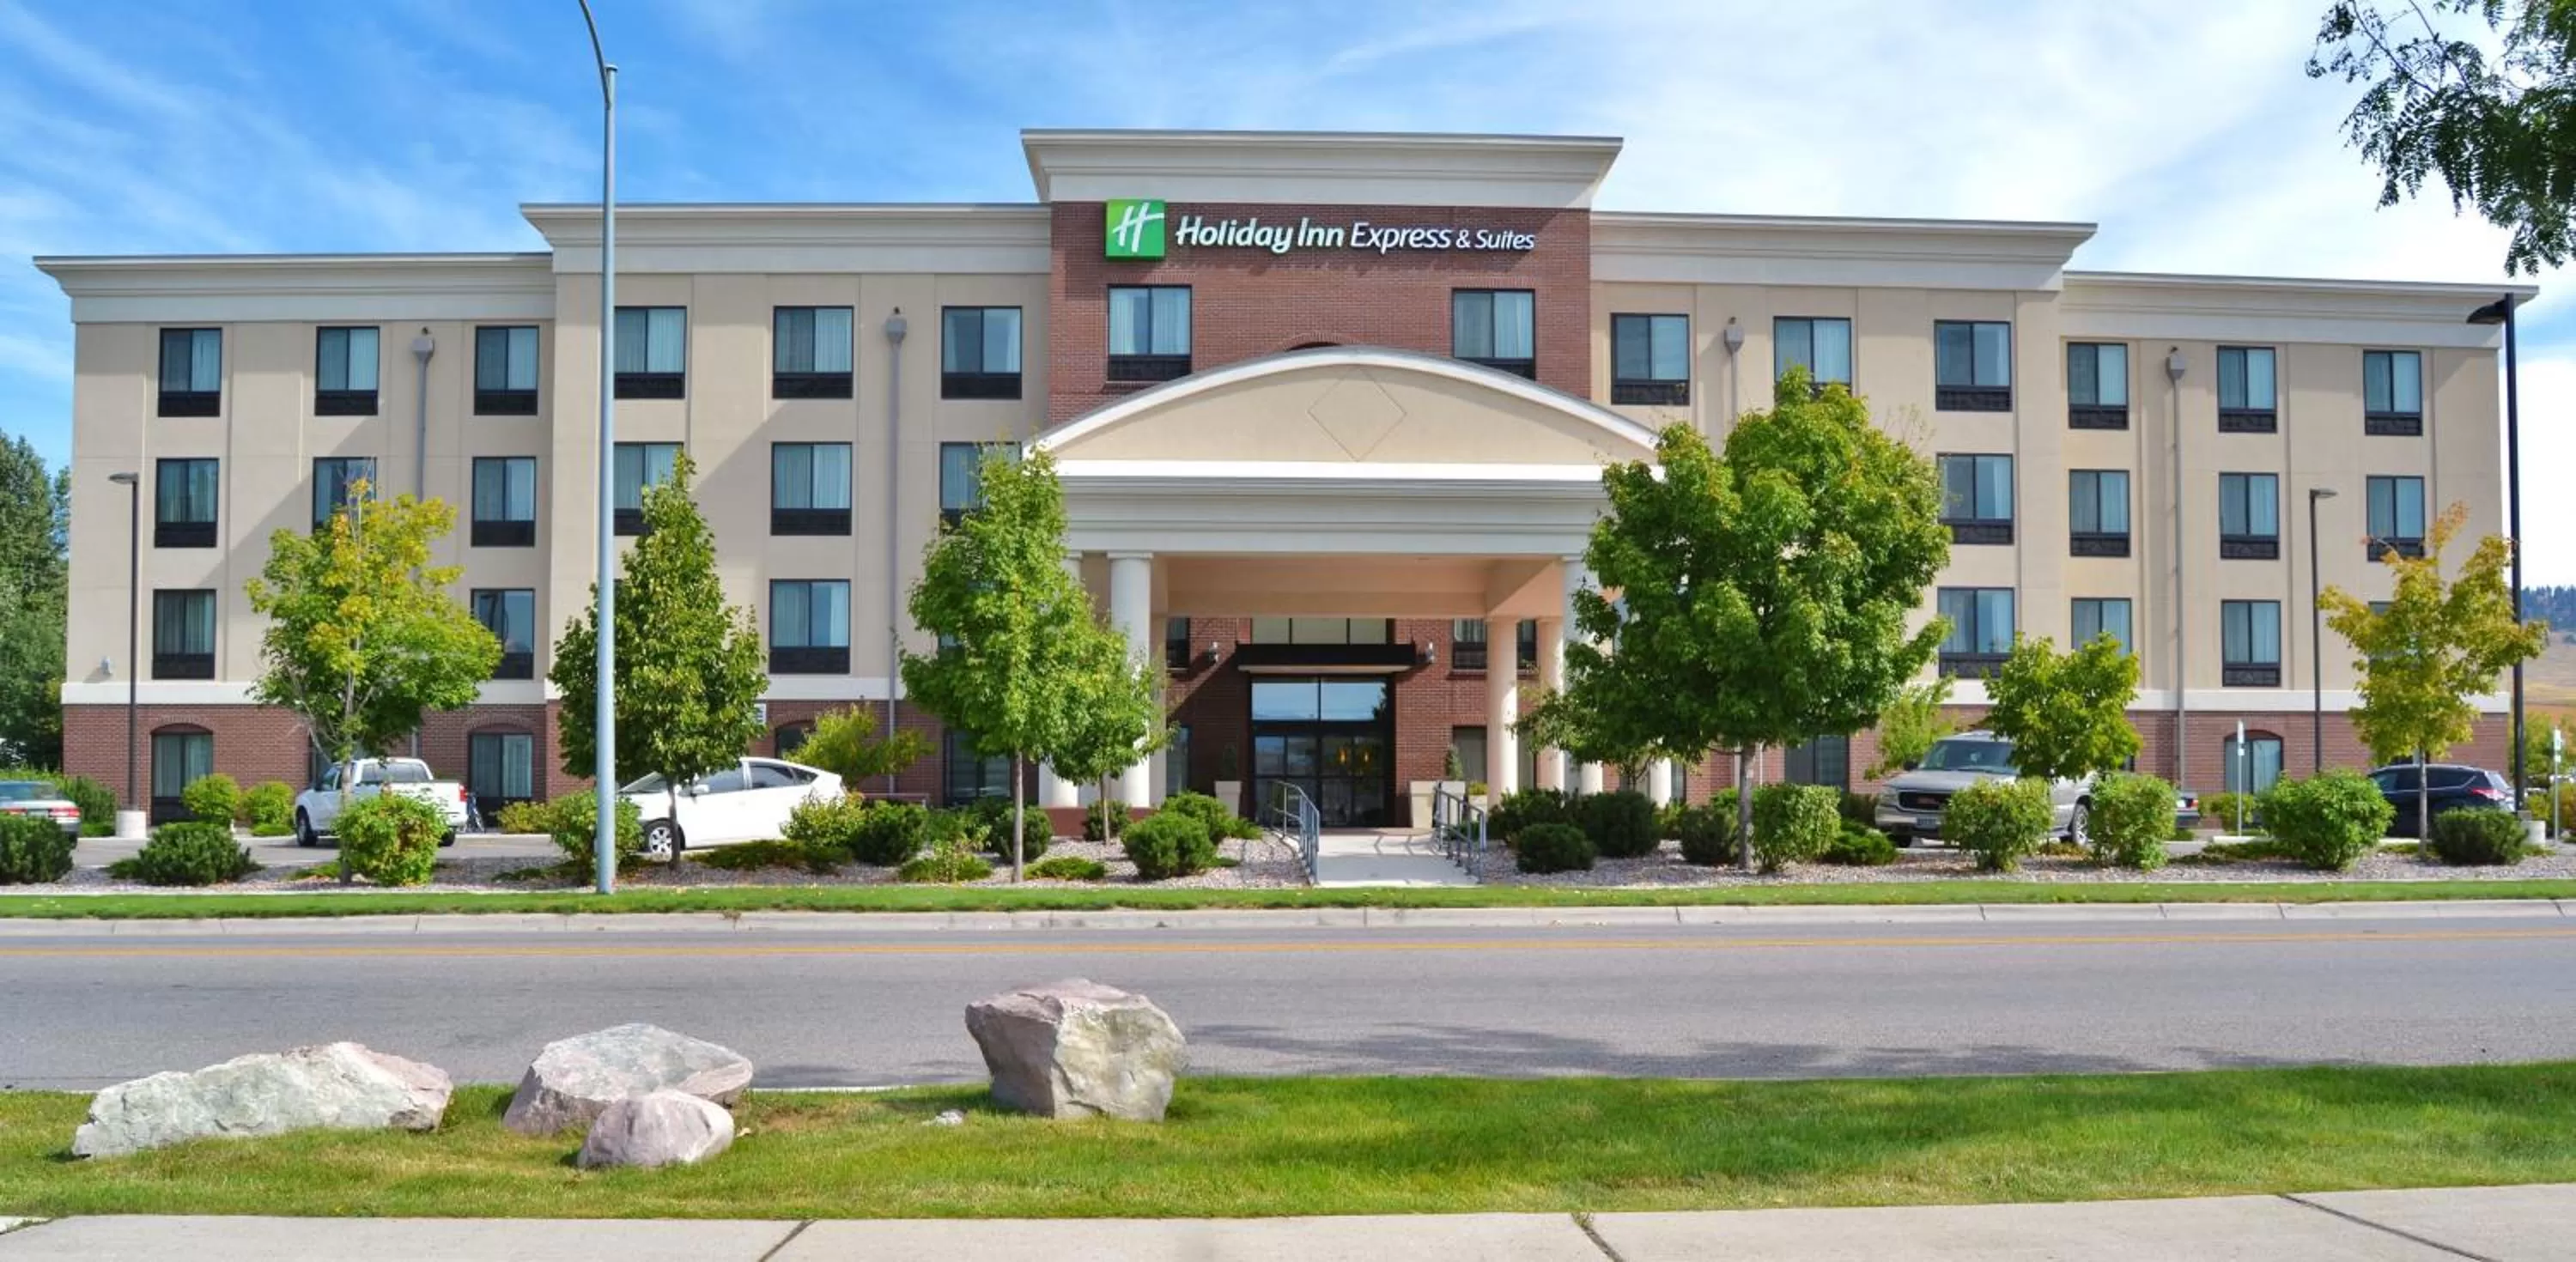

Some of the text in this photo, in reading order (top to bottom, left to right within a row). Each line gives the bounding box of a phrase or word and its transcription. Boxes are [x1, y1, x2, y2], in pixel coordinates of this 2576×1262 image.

[1176, 215, 1535, 255] Holiday Inn Express & Suites
